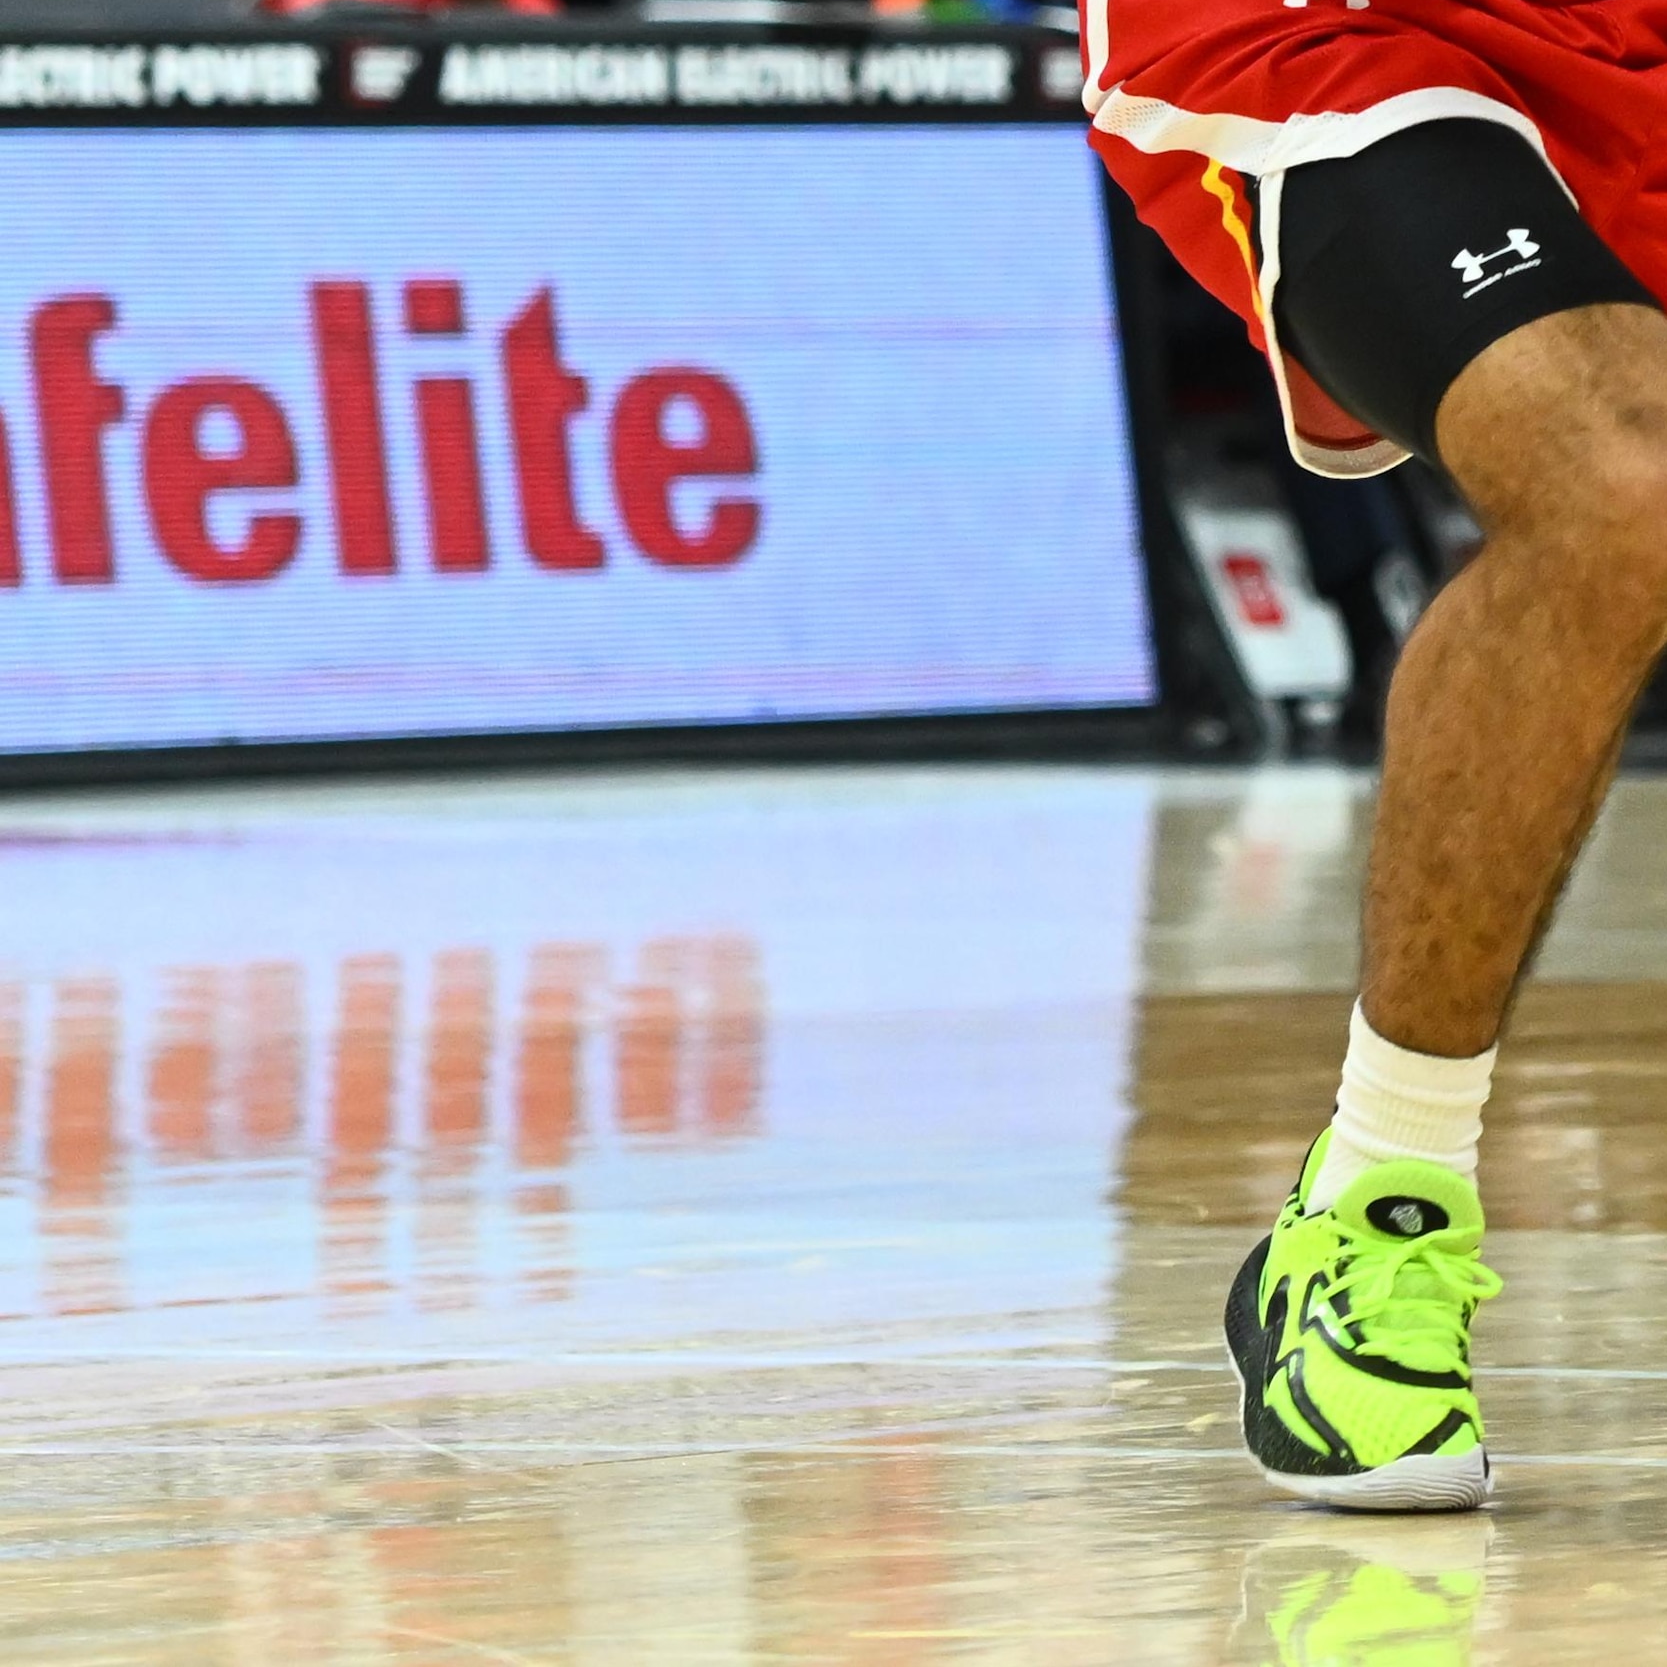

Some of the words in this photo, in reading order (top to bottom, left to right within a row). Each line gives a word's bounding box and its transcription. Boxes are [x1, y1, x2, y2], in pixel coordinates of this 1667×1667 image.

[152, 44, 322, 107] POWER
[438, 43, 668, 105] AMERICAN
[674, 43, 855, 105] ELECTRIC
[857, 43, 1014, 105] POWER
[0, 277, 761, 587] felite
